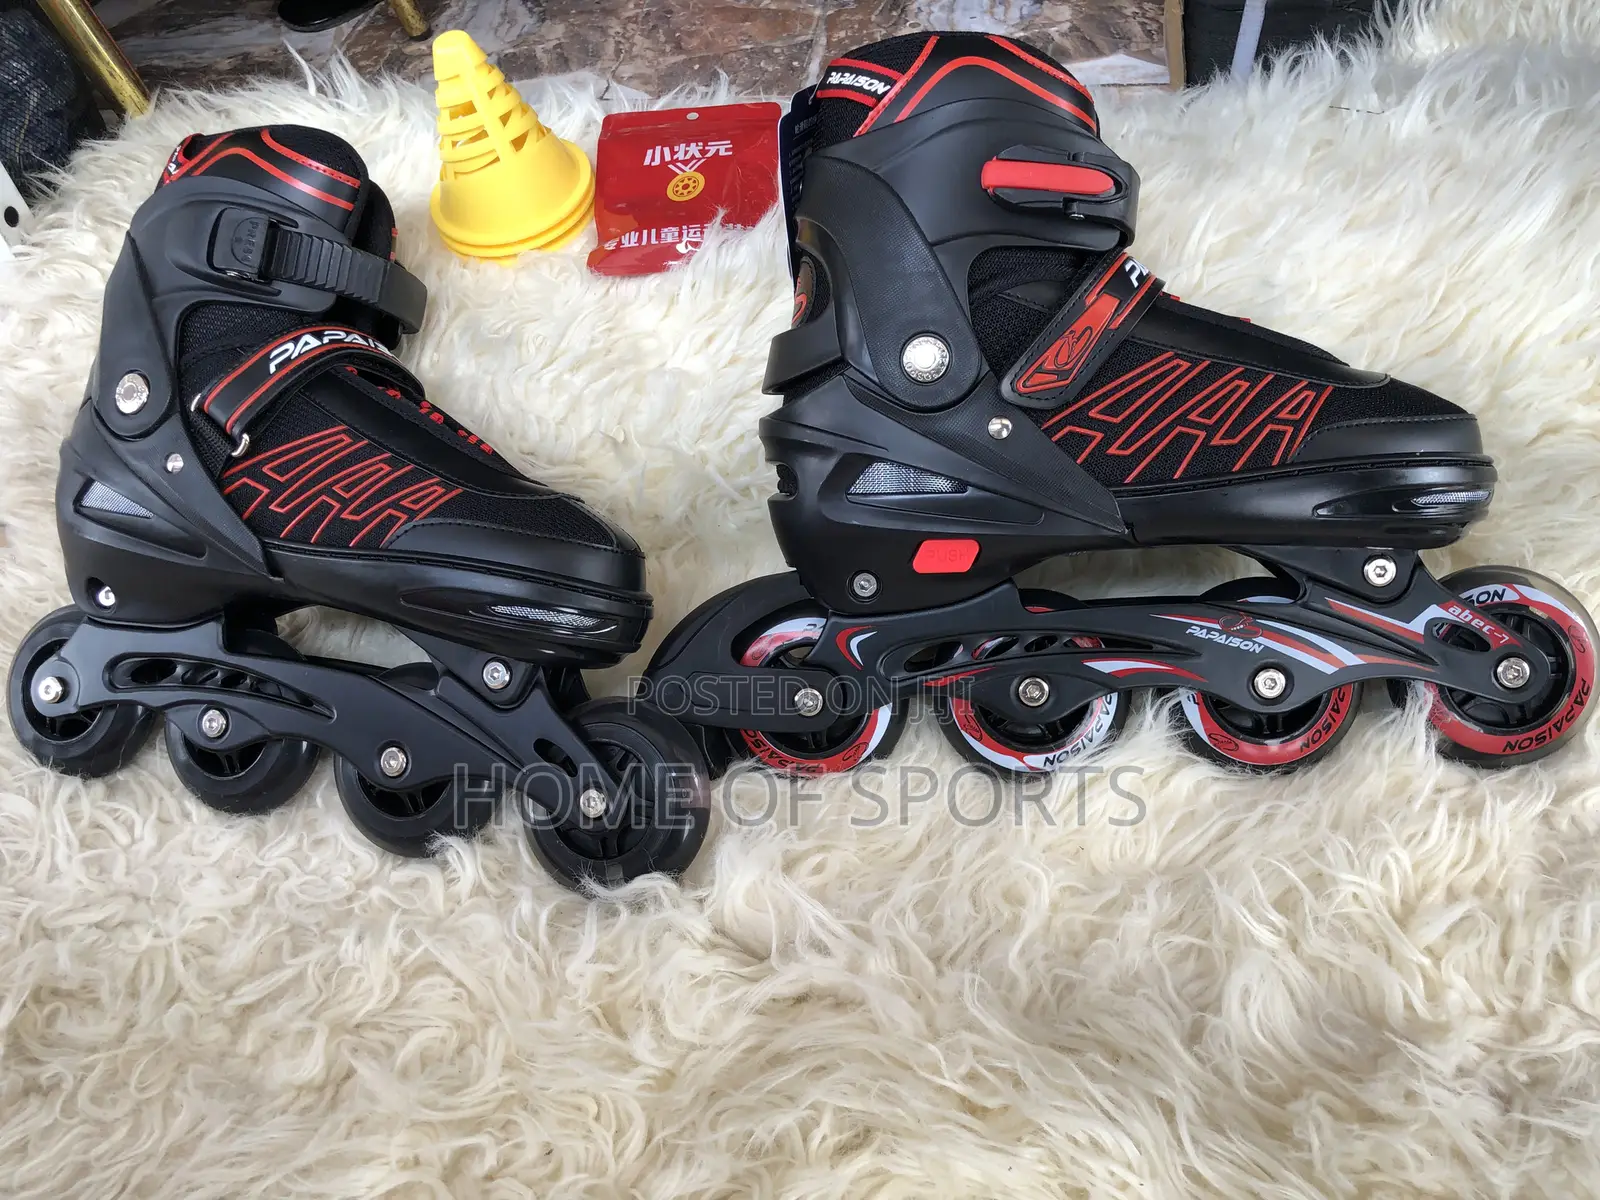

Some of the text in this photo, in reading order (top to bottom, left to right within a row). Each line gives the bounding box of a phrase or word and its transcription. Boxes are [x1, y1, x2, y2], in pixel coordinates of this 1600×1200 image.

[826, 72, 891, 95] PAPAISON
[643, 140, 733, 166] 小状元
[1448, 605, 1509, 643] abec-7
[1185, 625, 1264, 654] PAPAISON
[1502, 678, 1592, 753] PAPAISON
